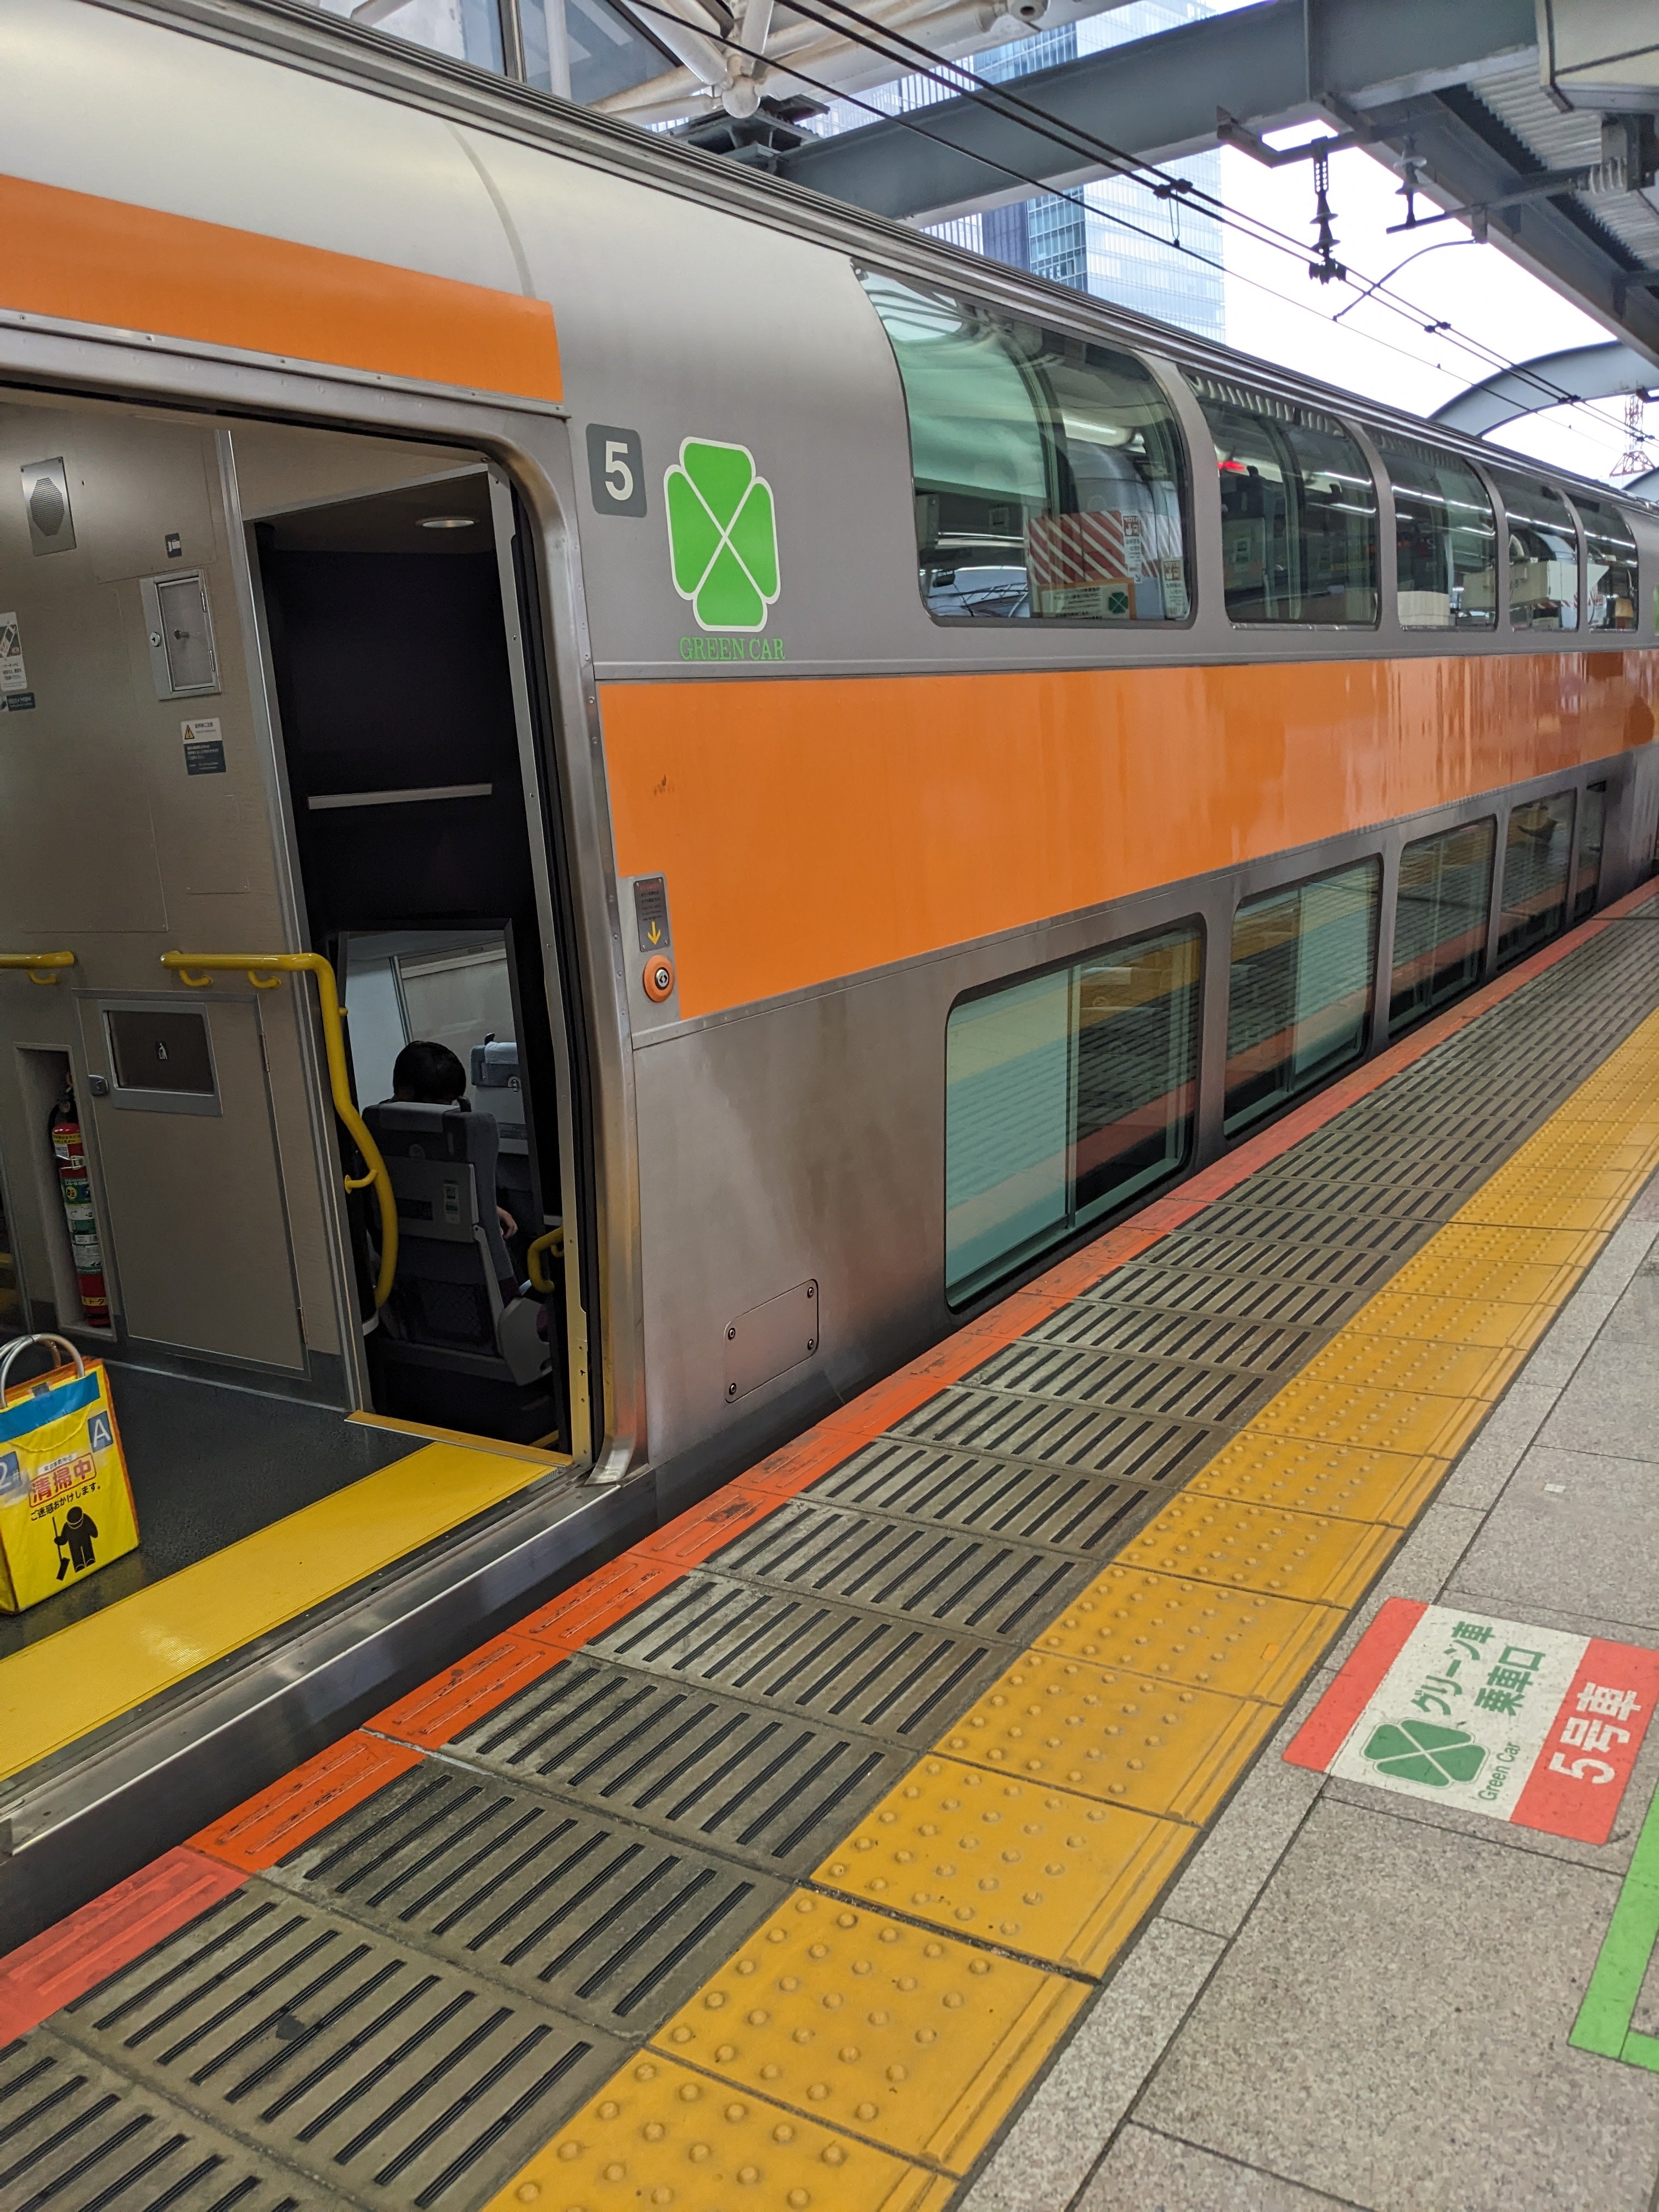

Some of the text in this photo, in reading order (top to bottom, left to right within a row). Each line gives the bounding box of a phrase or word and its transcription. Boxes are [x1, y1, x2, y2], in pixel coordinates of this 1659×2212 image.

[605, 441, 634, 500] 5
[679, 636, 786, 661] GREEN CAR
[93, 1418, 111, 1449] A
[31, 1459, 92, 1504] 清掃中
[31, 1482, 101, 1521] ご迷惑おかけします。
[1410, 1621, 1496, 1716] グリーン車
[1474, 1645, 1546, 1716] 乗車口
[1548, 1681, 1641, 1785] 5号車
[1478, 1741, 1521, 1801] Green Car
